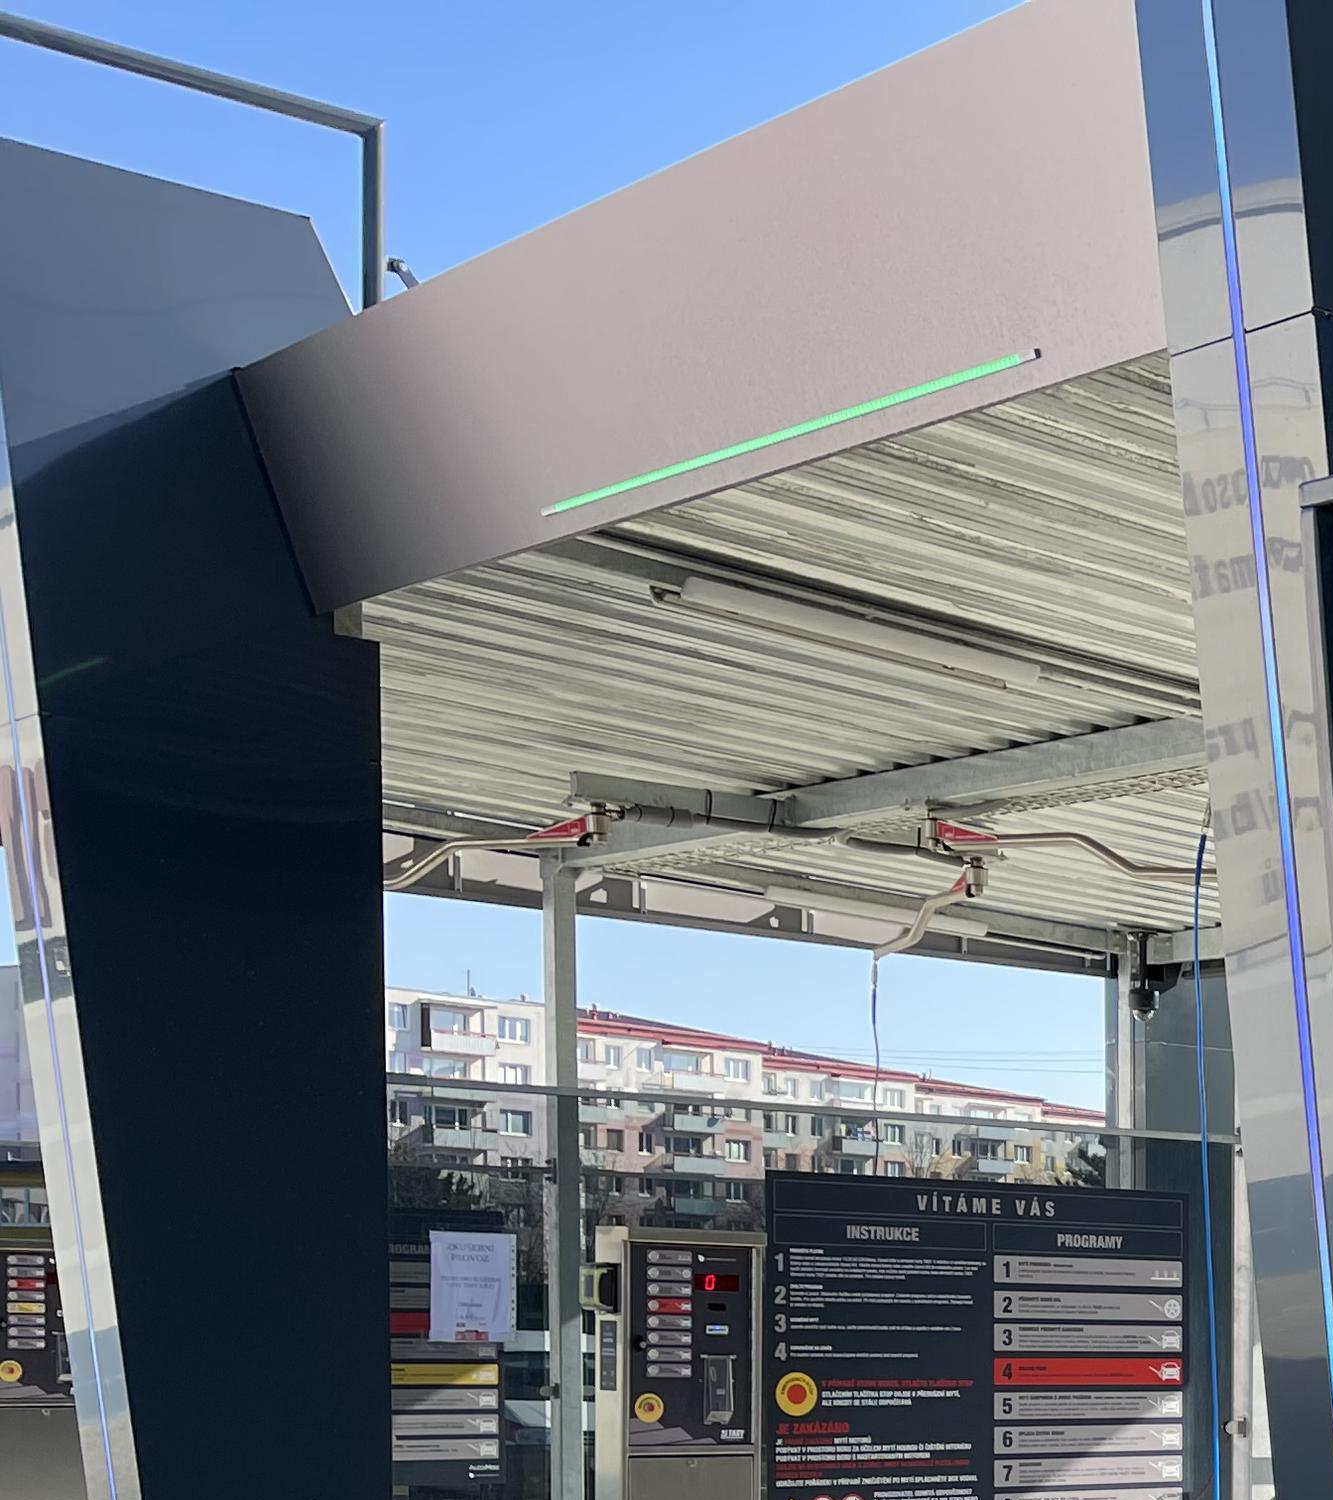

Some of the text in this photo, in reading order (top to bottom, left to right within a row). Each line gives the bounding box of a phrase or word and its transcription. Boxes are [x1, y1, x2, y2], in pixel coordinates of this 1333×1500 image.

[917, 1191, 1056, 1217] VÍTÁME VÁS
[846, 1225, 920, 1241] INSTRUKCE
[1057, 1233, 1123, 1249] PROGRAMY
[775, 1253, 784, 1272] 1
[1002, 1261, 1011, 1278] 1
[774, 1286, 786, 1305] 2
[1002, 1297, 1012, 1313] 2
[774, 1314, 787, 1333] 3
[1002, 1329, 1012, 1346] 3
[774, 1343, 787, 1361] 4
[1002, 1363, 1012, 1381] 4
[1002, 1398, 1012, 1415] 5
[1002, 1431, 1013, 1448] 6
[1002, 1465, 1013, 1482] 7
